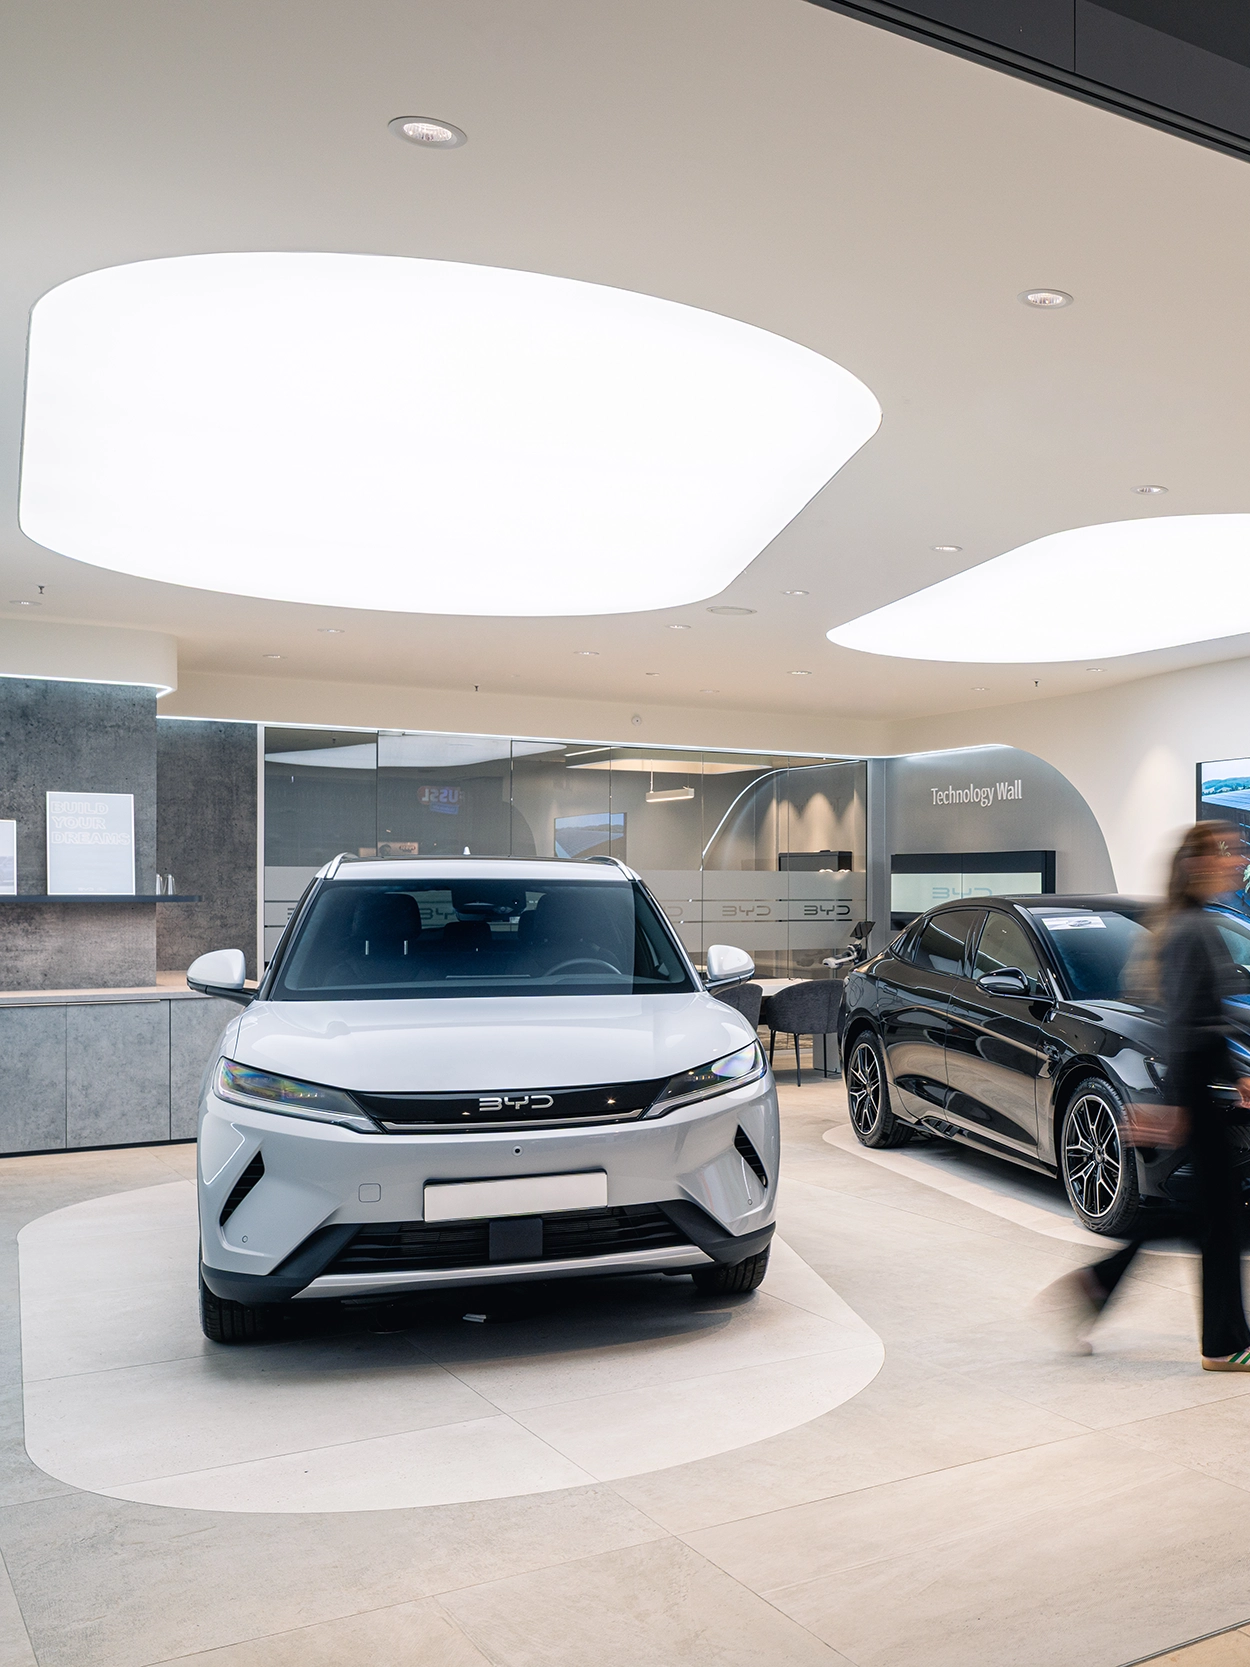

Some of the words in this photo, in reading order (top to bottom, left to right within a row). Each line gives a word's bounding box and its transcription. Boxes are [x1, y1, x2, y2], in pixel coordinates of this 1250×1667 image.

[930, 783, 995, 807] Technology
[996, 779, 1023, 800] Wall
[51, 801, 109, 815] BUILD
[51, 816, 107, 830] YOUR
[51, 831, 131, 846] DREAMS
[722, 905, 771, 917] BYD
[804, 905, 850, 916] BYD
[479, 1094, 554, 1111] BYD
